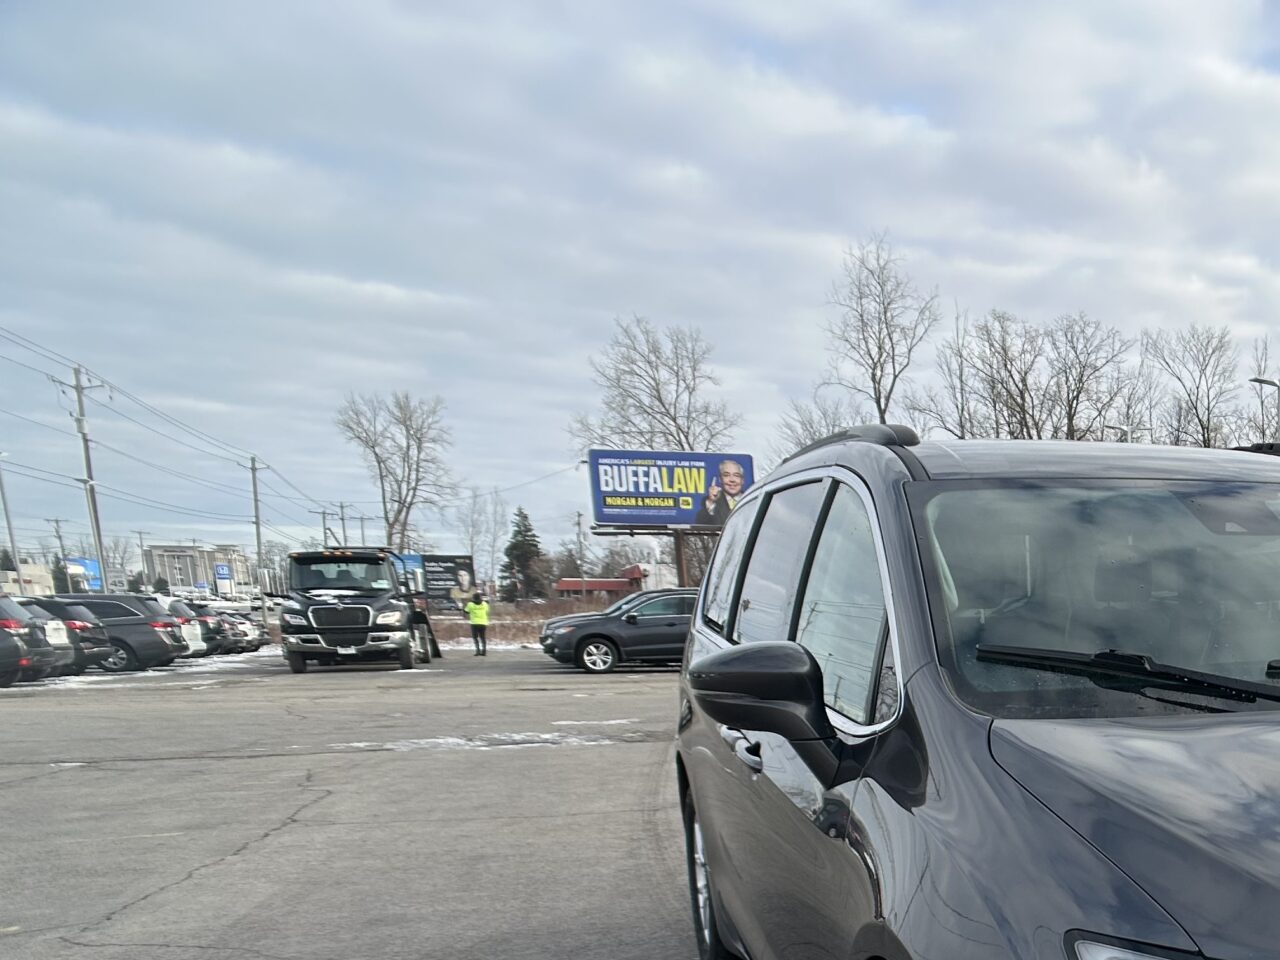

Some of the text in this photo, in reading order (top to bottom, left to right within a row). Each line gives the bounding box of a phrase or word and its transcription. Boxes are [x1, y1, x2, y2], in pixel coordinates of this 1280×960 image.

[599, 464, 705, 494] BUFFALAW
[605, 497, 634, 506] MORGAN
[644, 497, 674, 507] MORGAN
